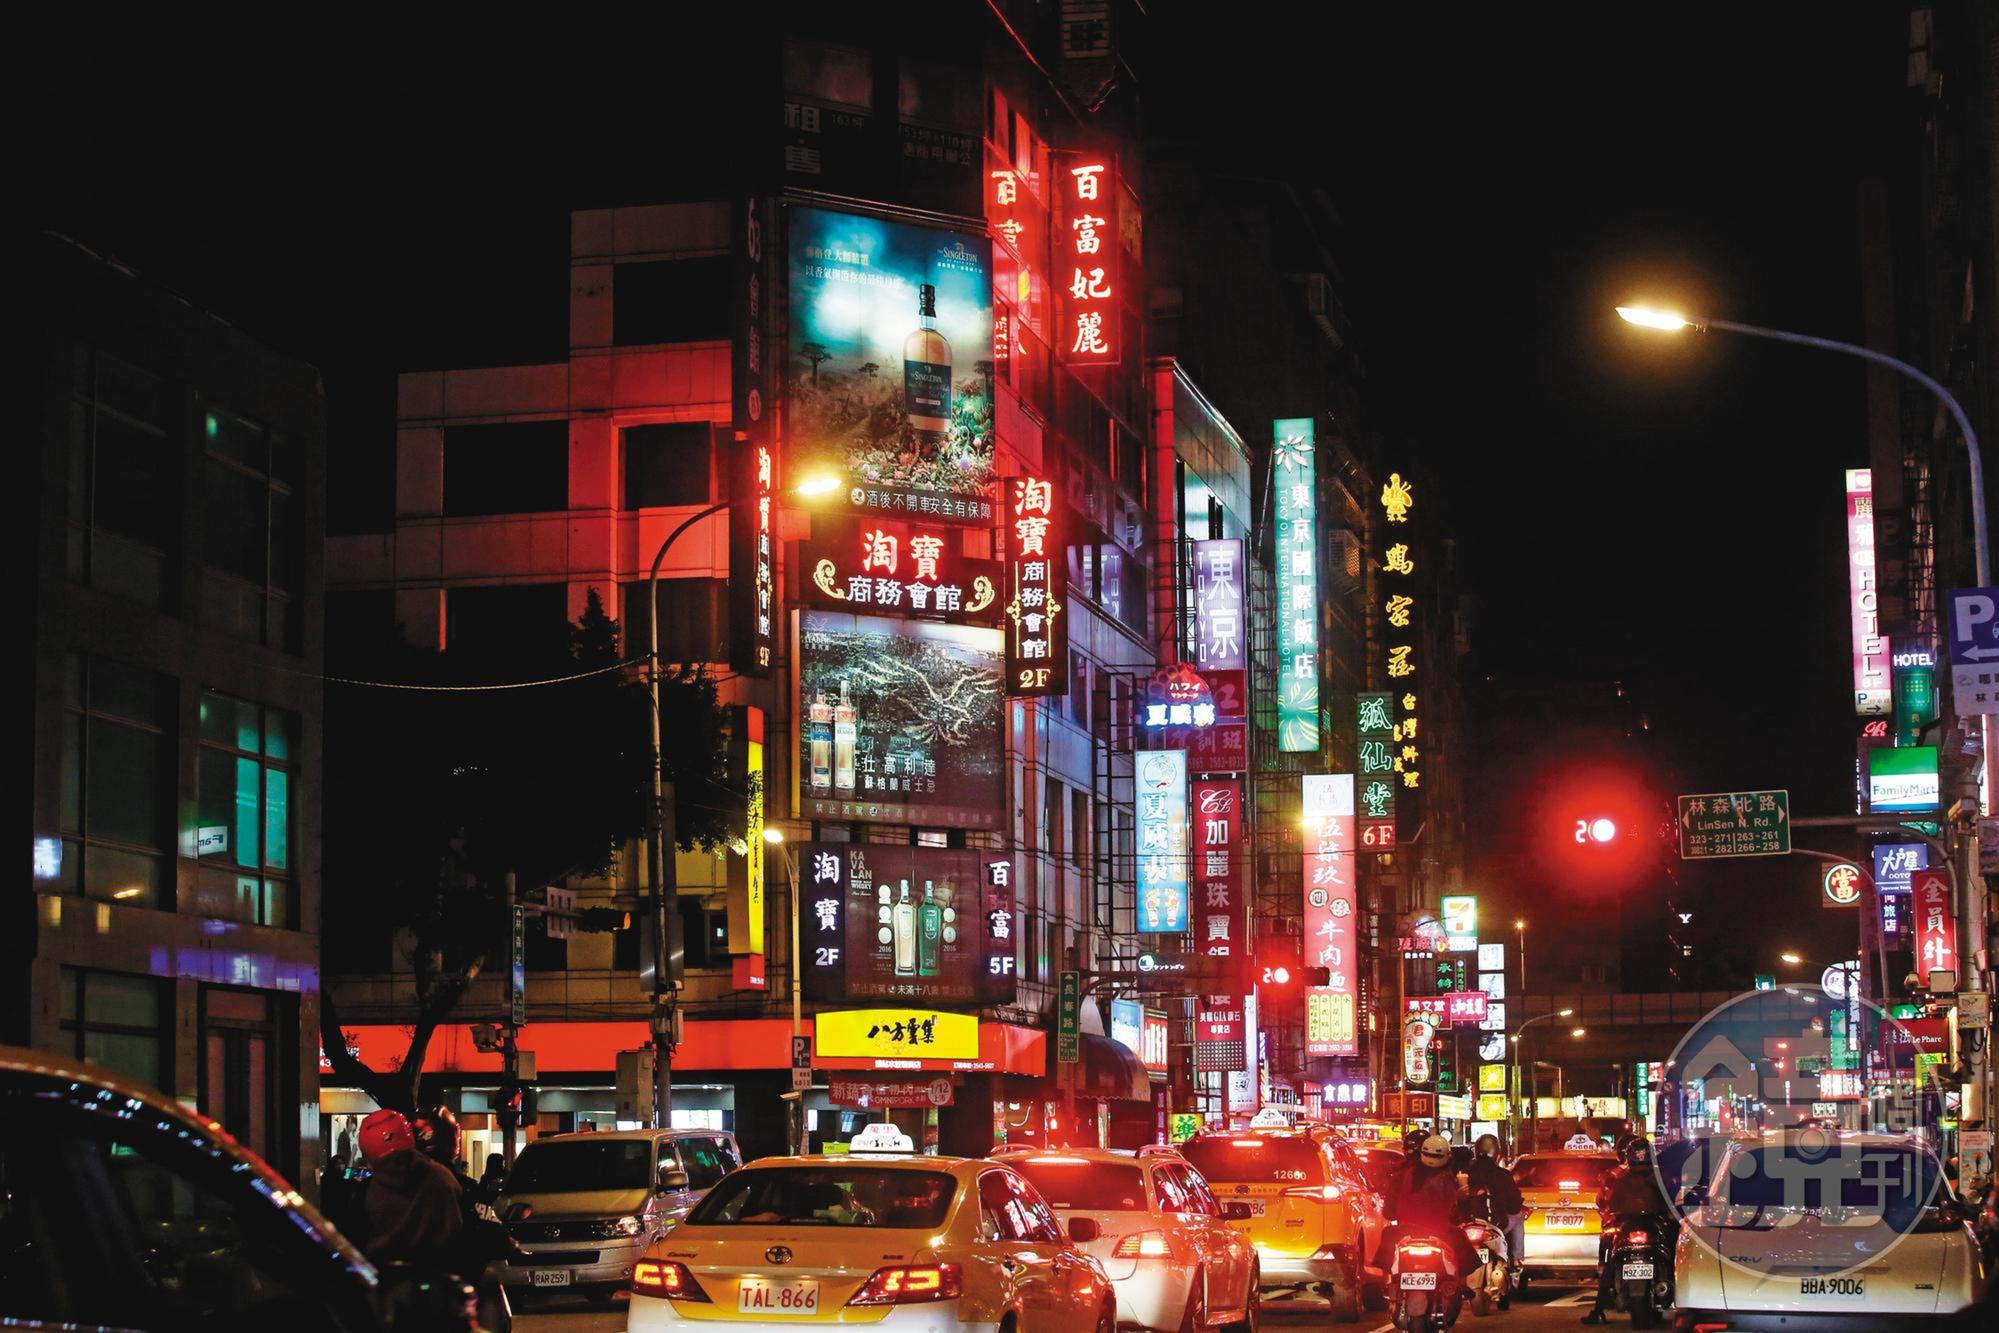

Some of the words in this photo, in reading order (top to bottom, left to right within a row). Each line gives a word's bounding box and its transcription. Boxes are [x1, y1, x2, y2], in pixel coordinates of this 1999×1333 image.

[1069, 164, 1111, 354] 百富妃麗
[866, 489, 992, 519] 酒後不開車安全有保障
[1280, 489, 1289, 530] TOKYO
[863, 529, 945, 580] 淘寶
[846, 574, 962, 612] 商務會館
[1280, 534, 1290, 635] INTERNATIONAL
[1290, 484, 1314, 680] 東京國際飯店
[1021, 560, 1047, 658] 商務會館
[1197, 551, 1207, 662] TOKYO
[1207, 545, 1240, 658] 東京
[1954, 594, 1995, 641] P
[1858, 571, 1882, 678] HOTEL
[1281, 638, 1291, 678] HOTEL
[1893, 653, 1933, 667] HOTEL
[1019, 669, 1051, 688] 2F
[1169, 682, 1201, 691] ハワイ
[1858, 693, 1867, 705] P
[1359, 698, 1393, 817] 狐仙堂
[1688, 794, 1776, 816] 林森北路
[1873, 784, 1936, 798] FamilyMart
[1363, 826, 1393, 845] 6F
[1697, 820, 1734, 831] LinSen
[1754, 817, 1772, 827] Rd.
[814, 851, 840, 932] 淘寶
[988, 860, 1012, 940] 百富
[1831, 867, 1857, 900] 當
[815, 948, 839, 966] 2F
[989, 957, 1014, 975] 5F
[867, 1018, 936, 1045] 八方雲集
[742, 1287, 815, 1309] TAL-866
[1801, 1277, 1863, 1296] BBA-9006
